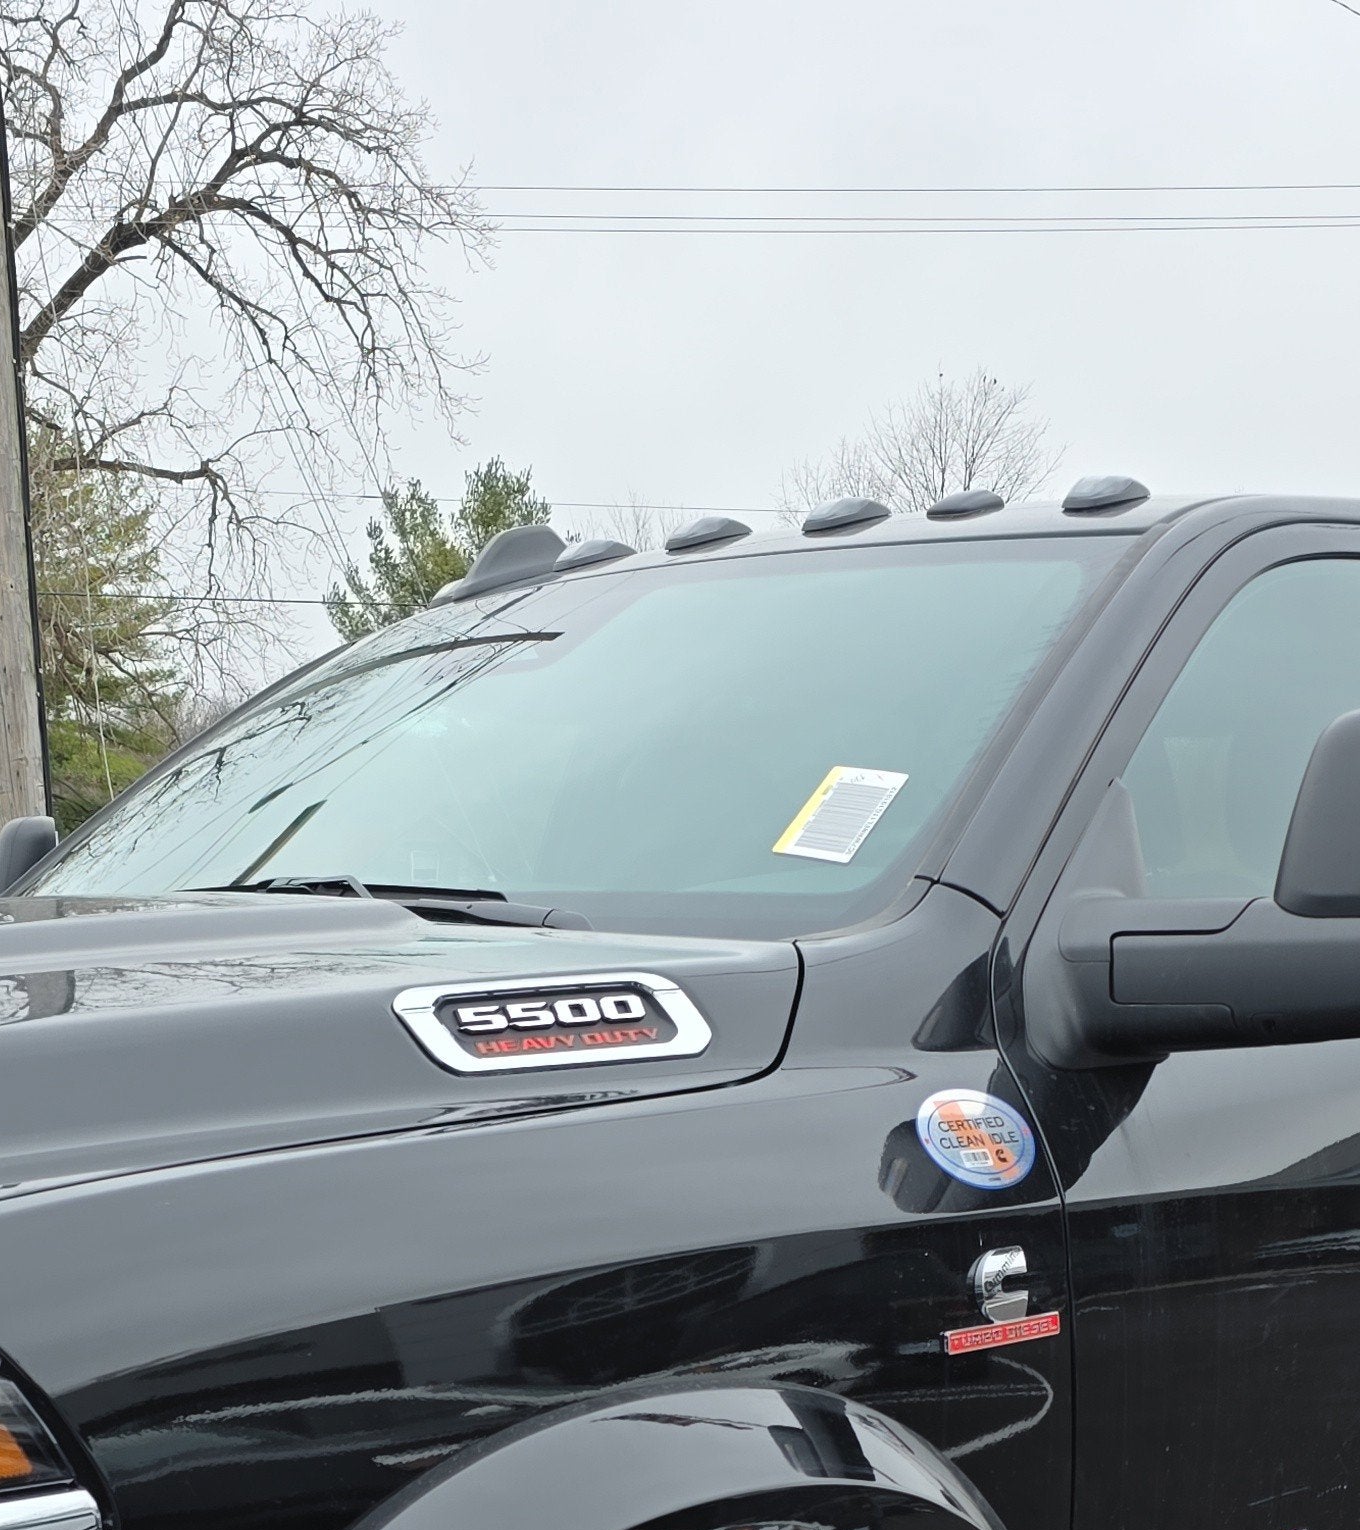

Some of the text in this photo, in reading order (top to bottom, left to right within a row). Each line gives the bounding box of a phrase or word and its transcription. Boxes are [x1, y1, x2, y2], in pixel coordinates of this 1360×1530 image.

[457, 995, 647, 1034] 5500
[474, 1028, 658, 1056] HEAVY DUTY
[938, 1116, 1005, 1132] CERTIFIED
[940, 1131, 1019, 1149] CLEAN IDLE
[950, 1319, 1057, 1349] TURBO DIESEL
